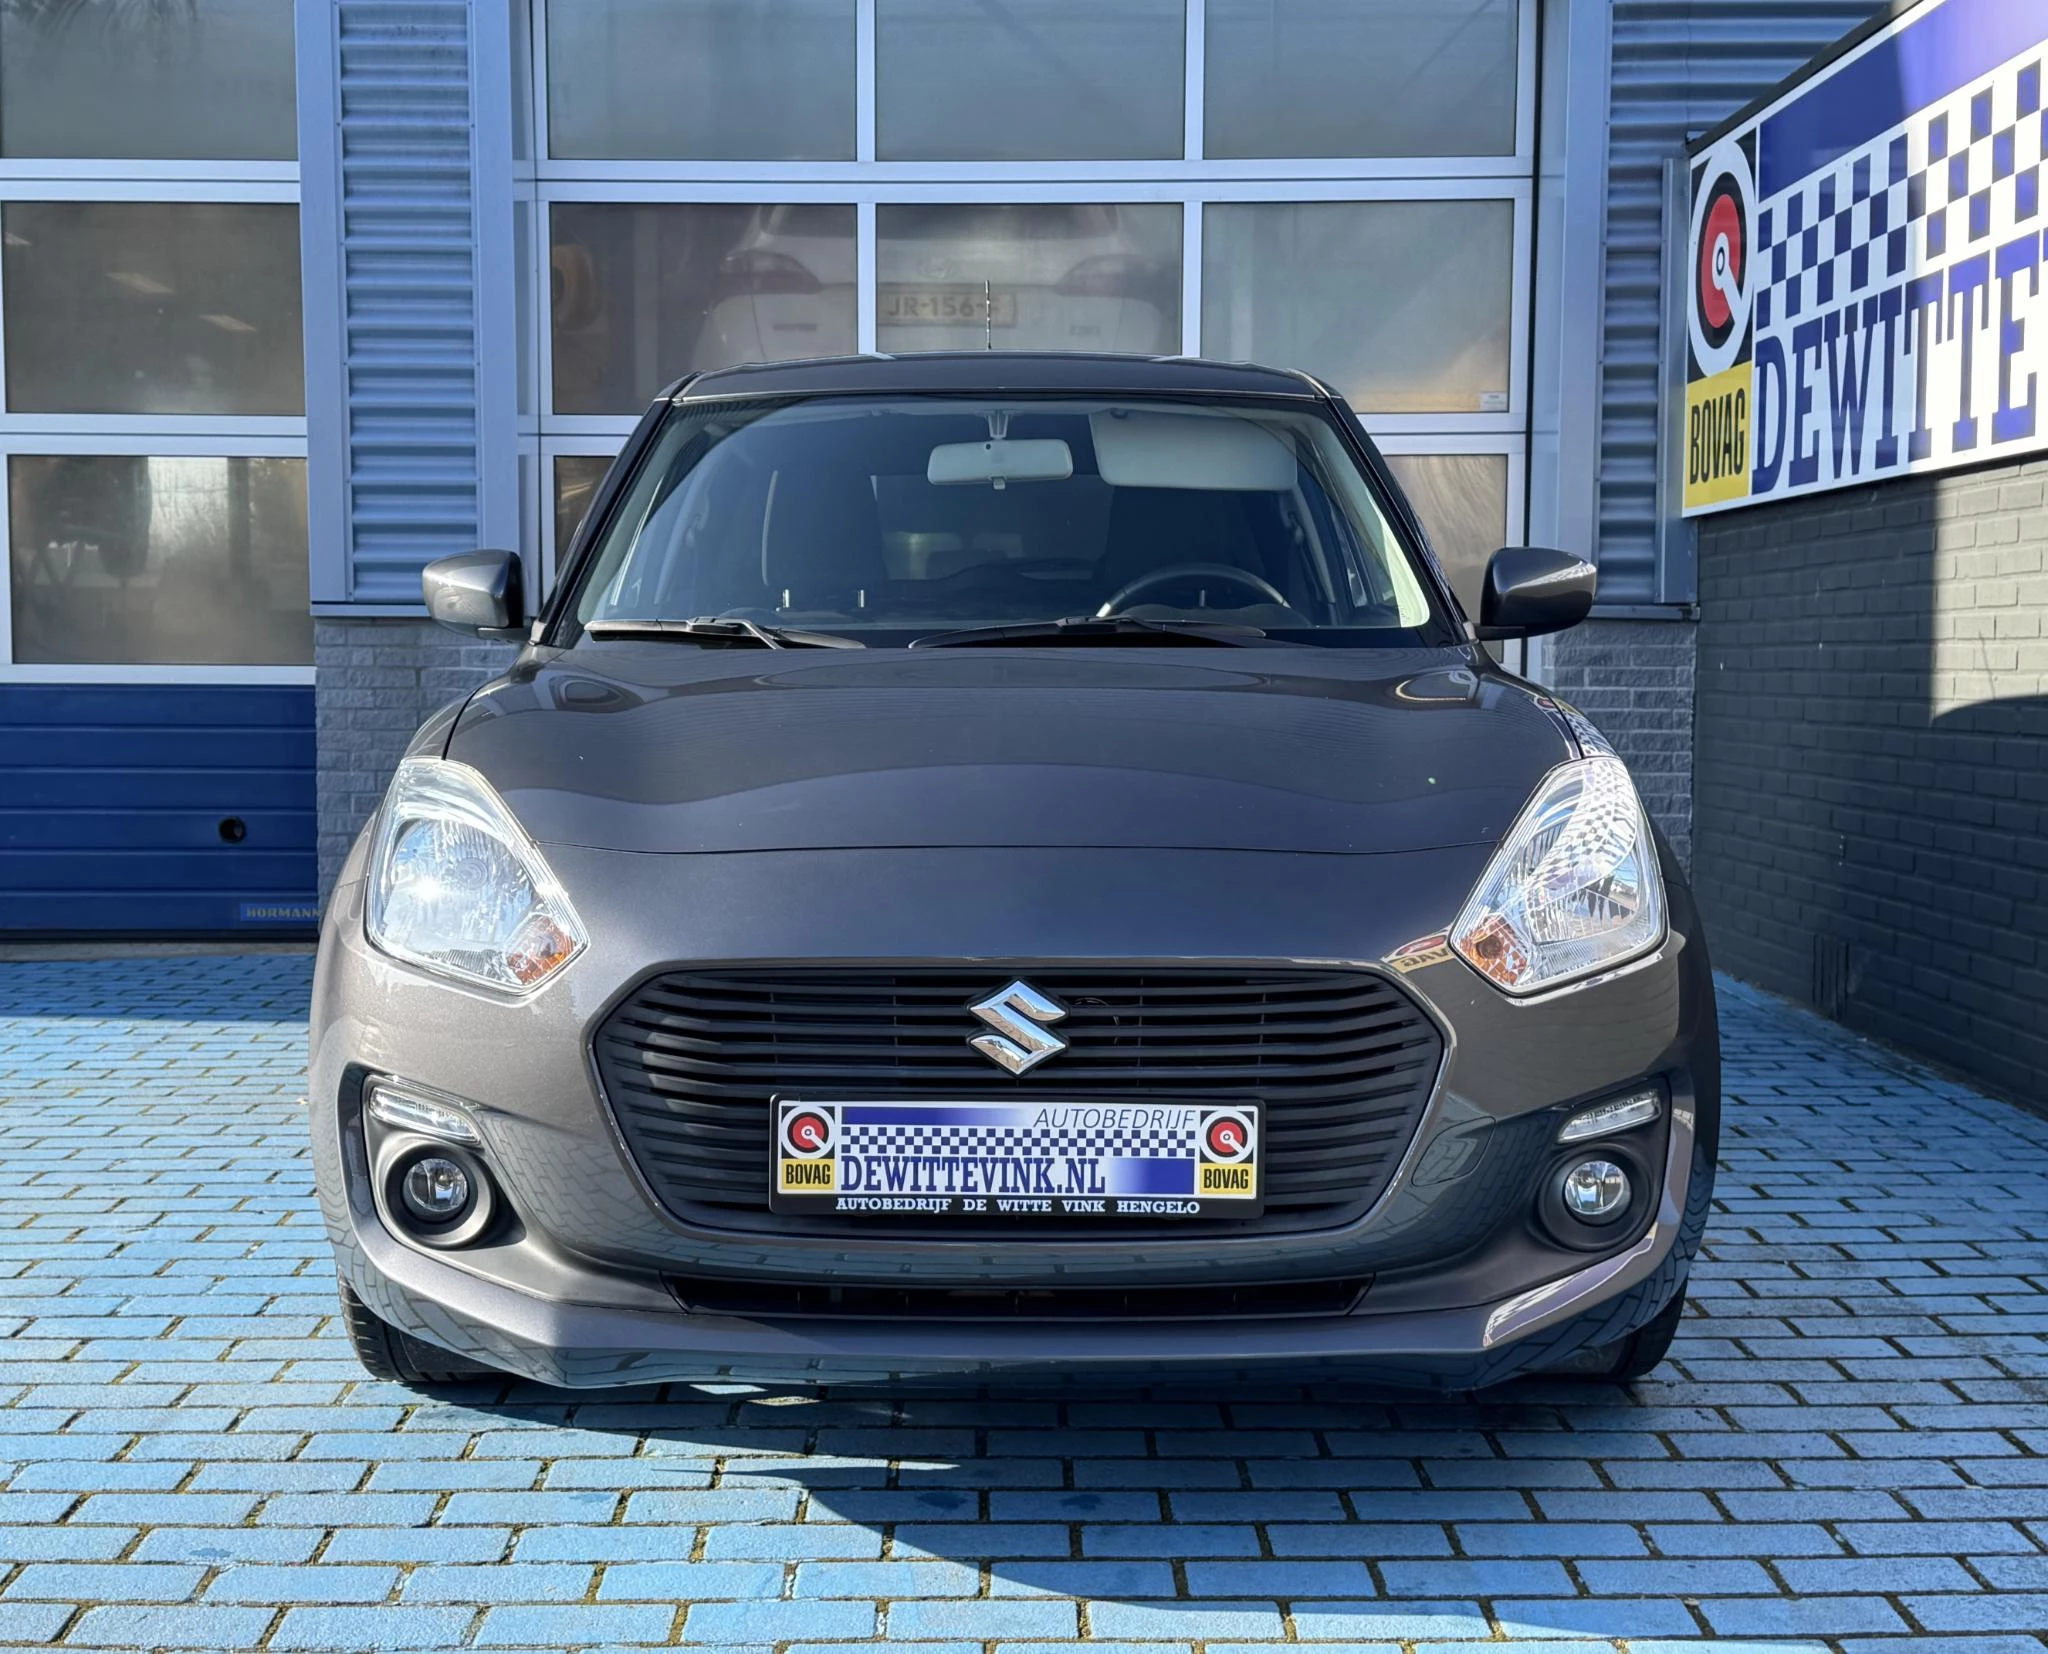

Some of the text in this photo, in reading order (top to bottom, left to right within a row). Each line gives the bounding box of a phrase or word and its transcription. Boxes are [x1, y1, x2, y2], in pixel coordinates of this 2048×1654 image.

[1752, 228, 2048, 497] DEWITTE
[1690, 388, 1746, 485] BOVAG
[1033, 1108, 1196, 1130] AUTOBEDRIJF
[785, 1164, 831, 1185] BOVAG
[841, 1155, 1106, 1194] DEWITTEVINK.NL
[1203, 1168, 1249, 1190] BOVAG
[835, 1197, 1201, 1214] AUTOBEDRIJF DE WITTE VINK HENGELO
